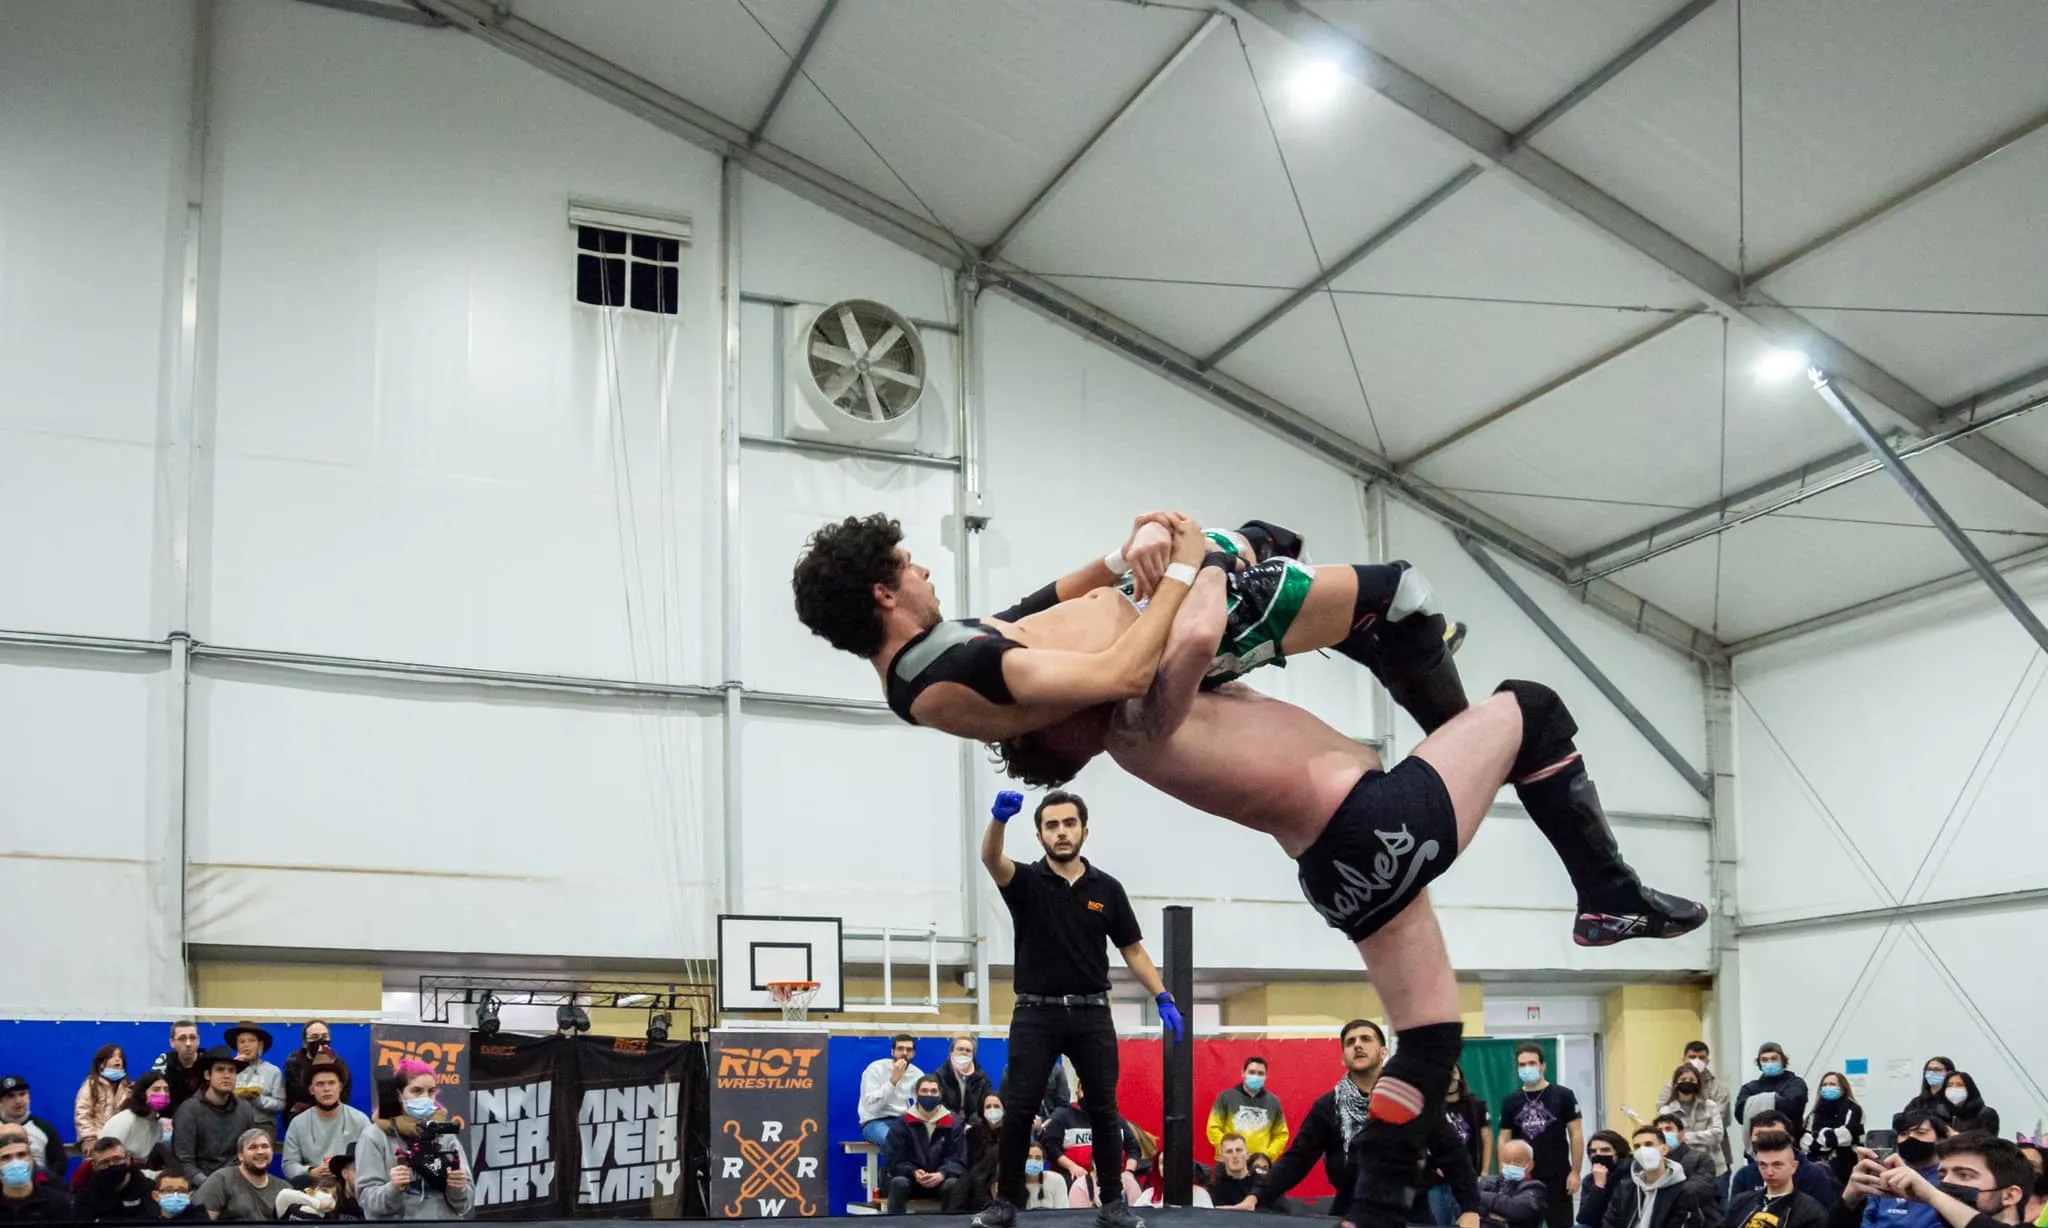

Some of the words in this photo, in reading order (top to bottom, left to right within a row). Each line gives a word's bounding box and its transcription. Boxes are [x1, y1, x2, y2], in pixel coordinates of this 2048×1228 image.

[376, 1040, 465, 1071] RIOT
[718, 1048, 822, 1077] RIOT
[717, 1078, 813, 1089] WRESTLING
[470, 1080, 552, 1124] NNI
[578, 1082, 680, 1124] ANNI
[579, 1116, 678, 1169] VER
[761, 1121, 783, 1142] R
[578, 1160, 681, 1204] SARY
[722, 1157, 743, 1178] R
[796, 1157, 818, 1178] R
[474, 1160, 555, 1206] ARY
[758, 1199, 786, 1217] W
